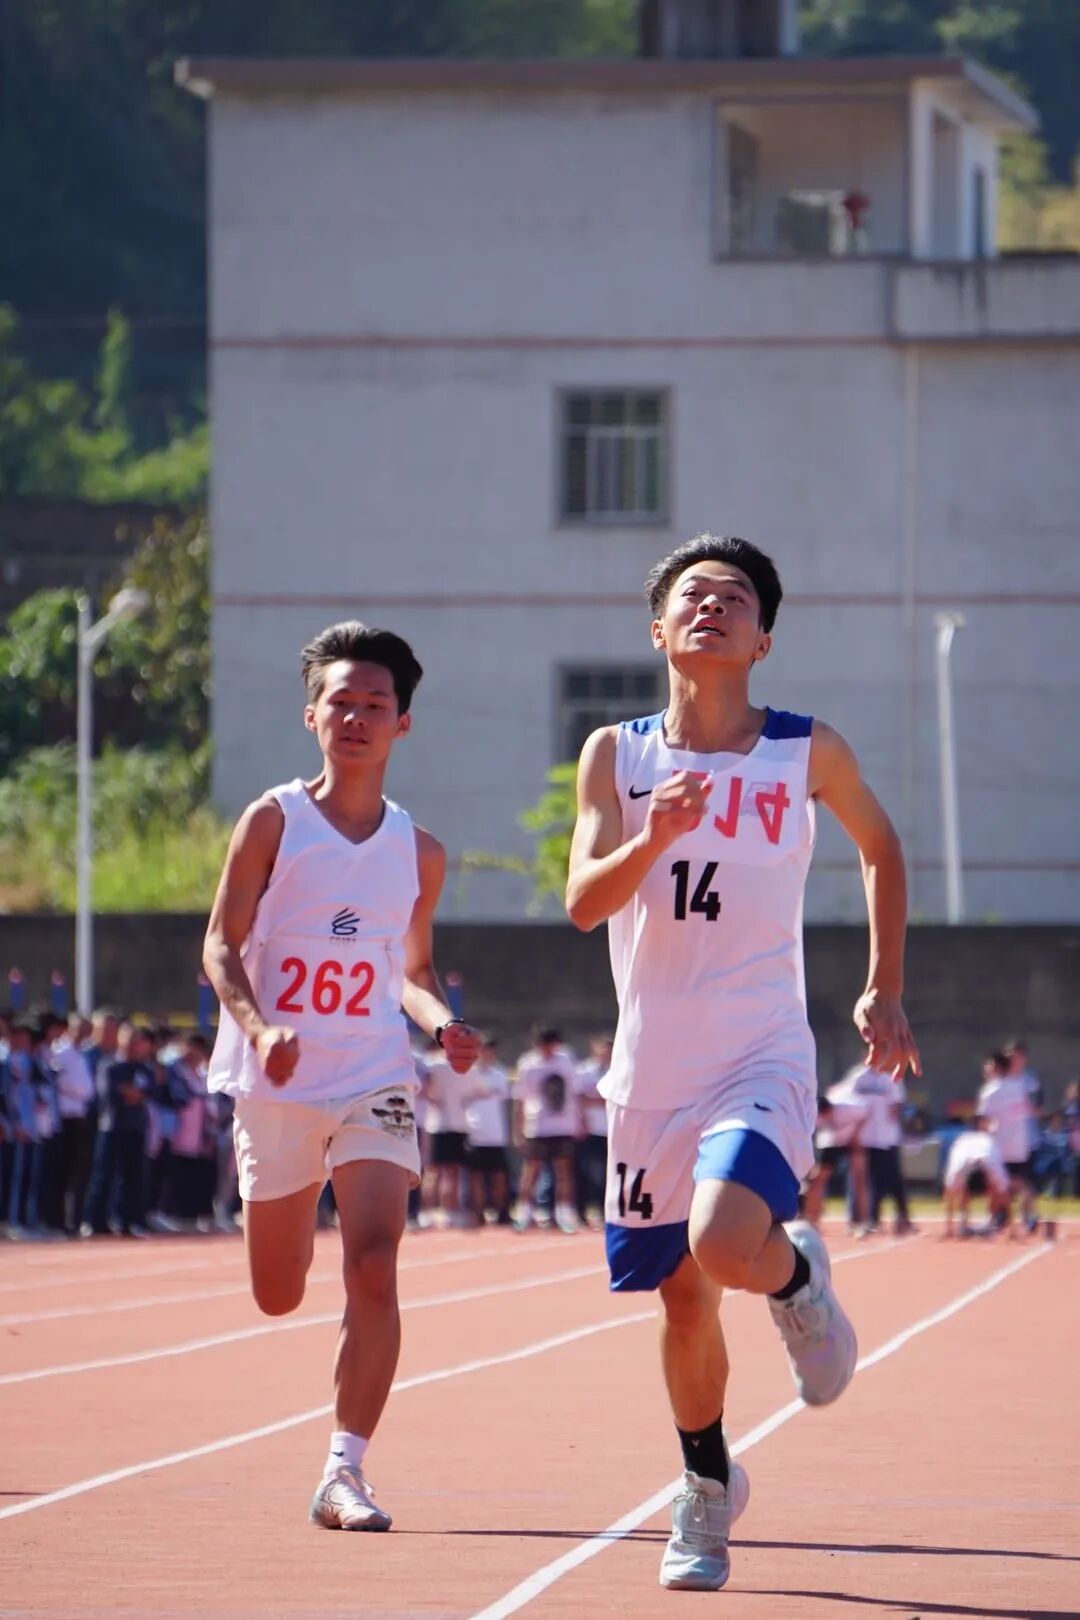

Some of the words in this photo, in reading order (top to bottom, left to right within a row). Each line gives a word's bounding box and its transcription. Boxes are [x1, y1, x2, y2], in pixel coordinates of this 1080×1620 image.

[670, 860, 721, 922] 14
[275, 957, 375, 1017] 262
[616, 1162, 653, 1220] 14
